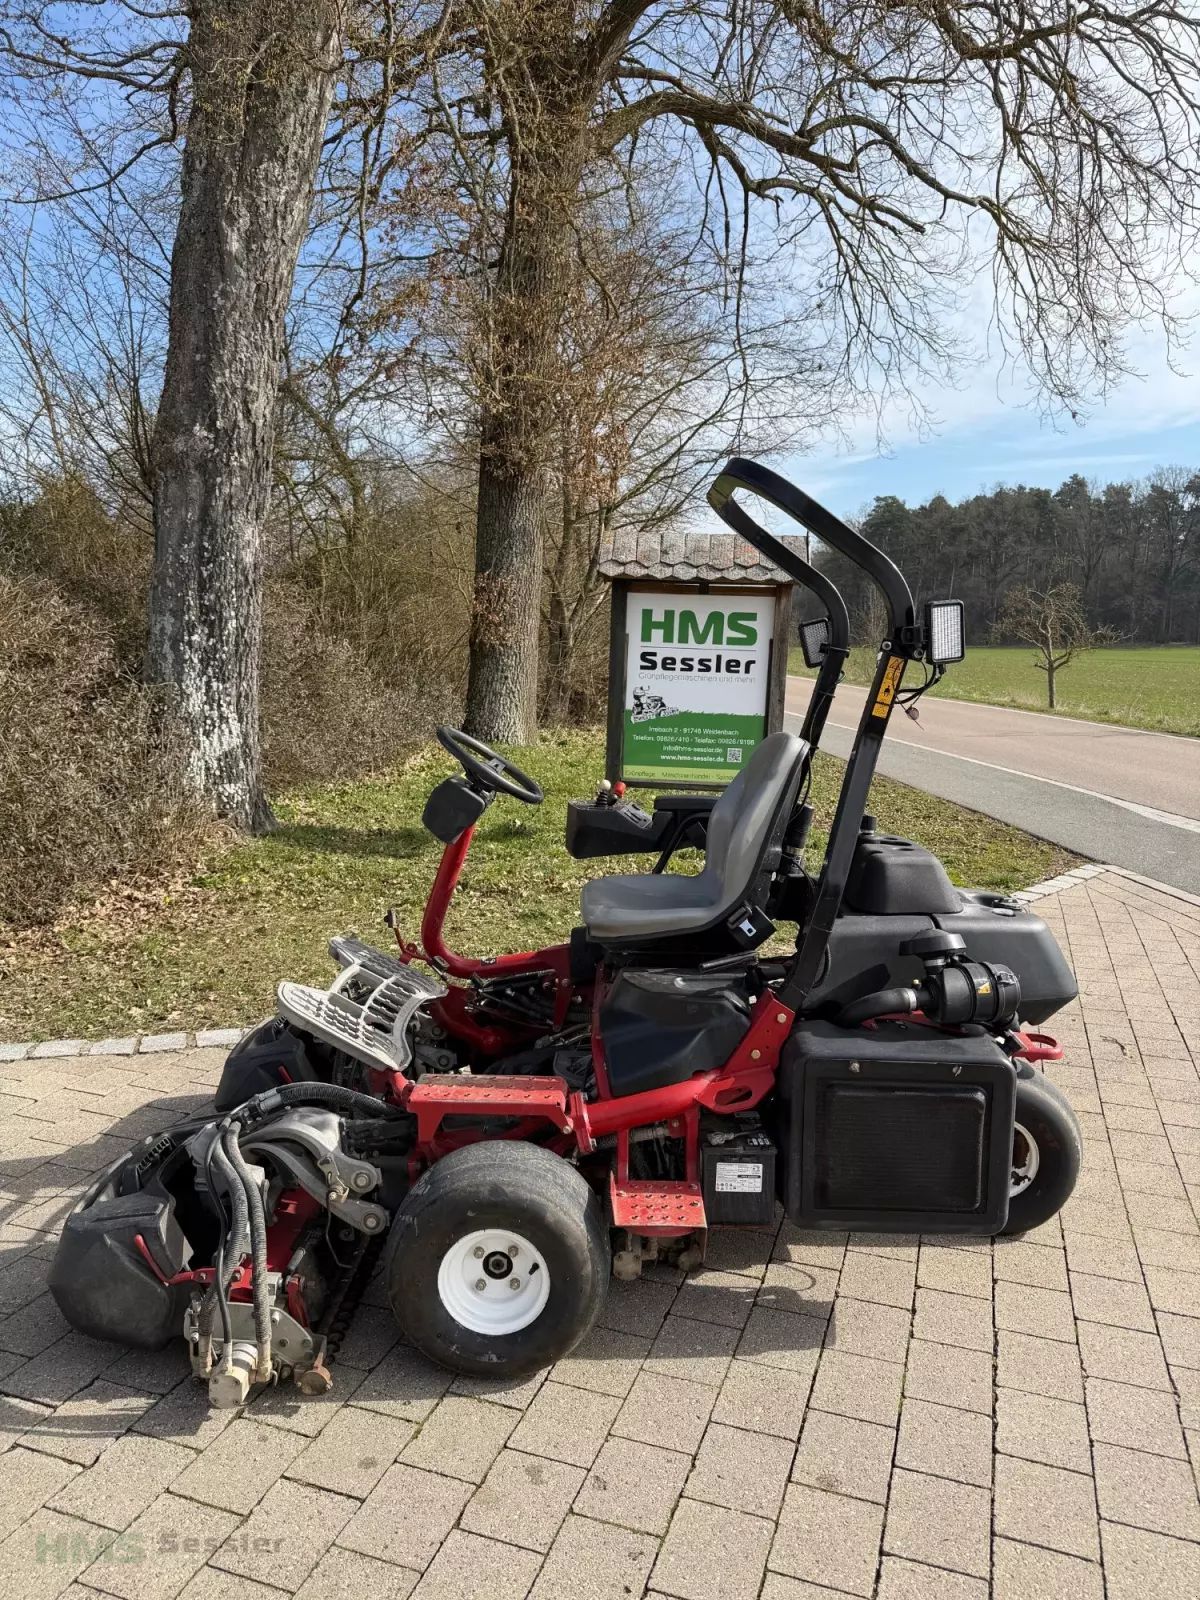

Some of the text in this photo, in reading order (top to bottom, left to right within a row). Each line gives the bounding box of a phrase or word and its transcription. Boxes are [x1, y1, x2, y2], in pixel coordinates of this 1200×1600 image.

[640, 608, 758, 647] HMS
[639, 651, 756, 674] Sessler
[638, 672, 755, 684] Grünpflegemaschinen und mehr
[660, 754, 724, 763] www.hms-sessler.de
